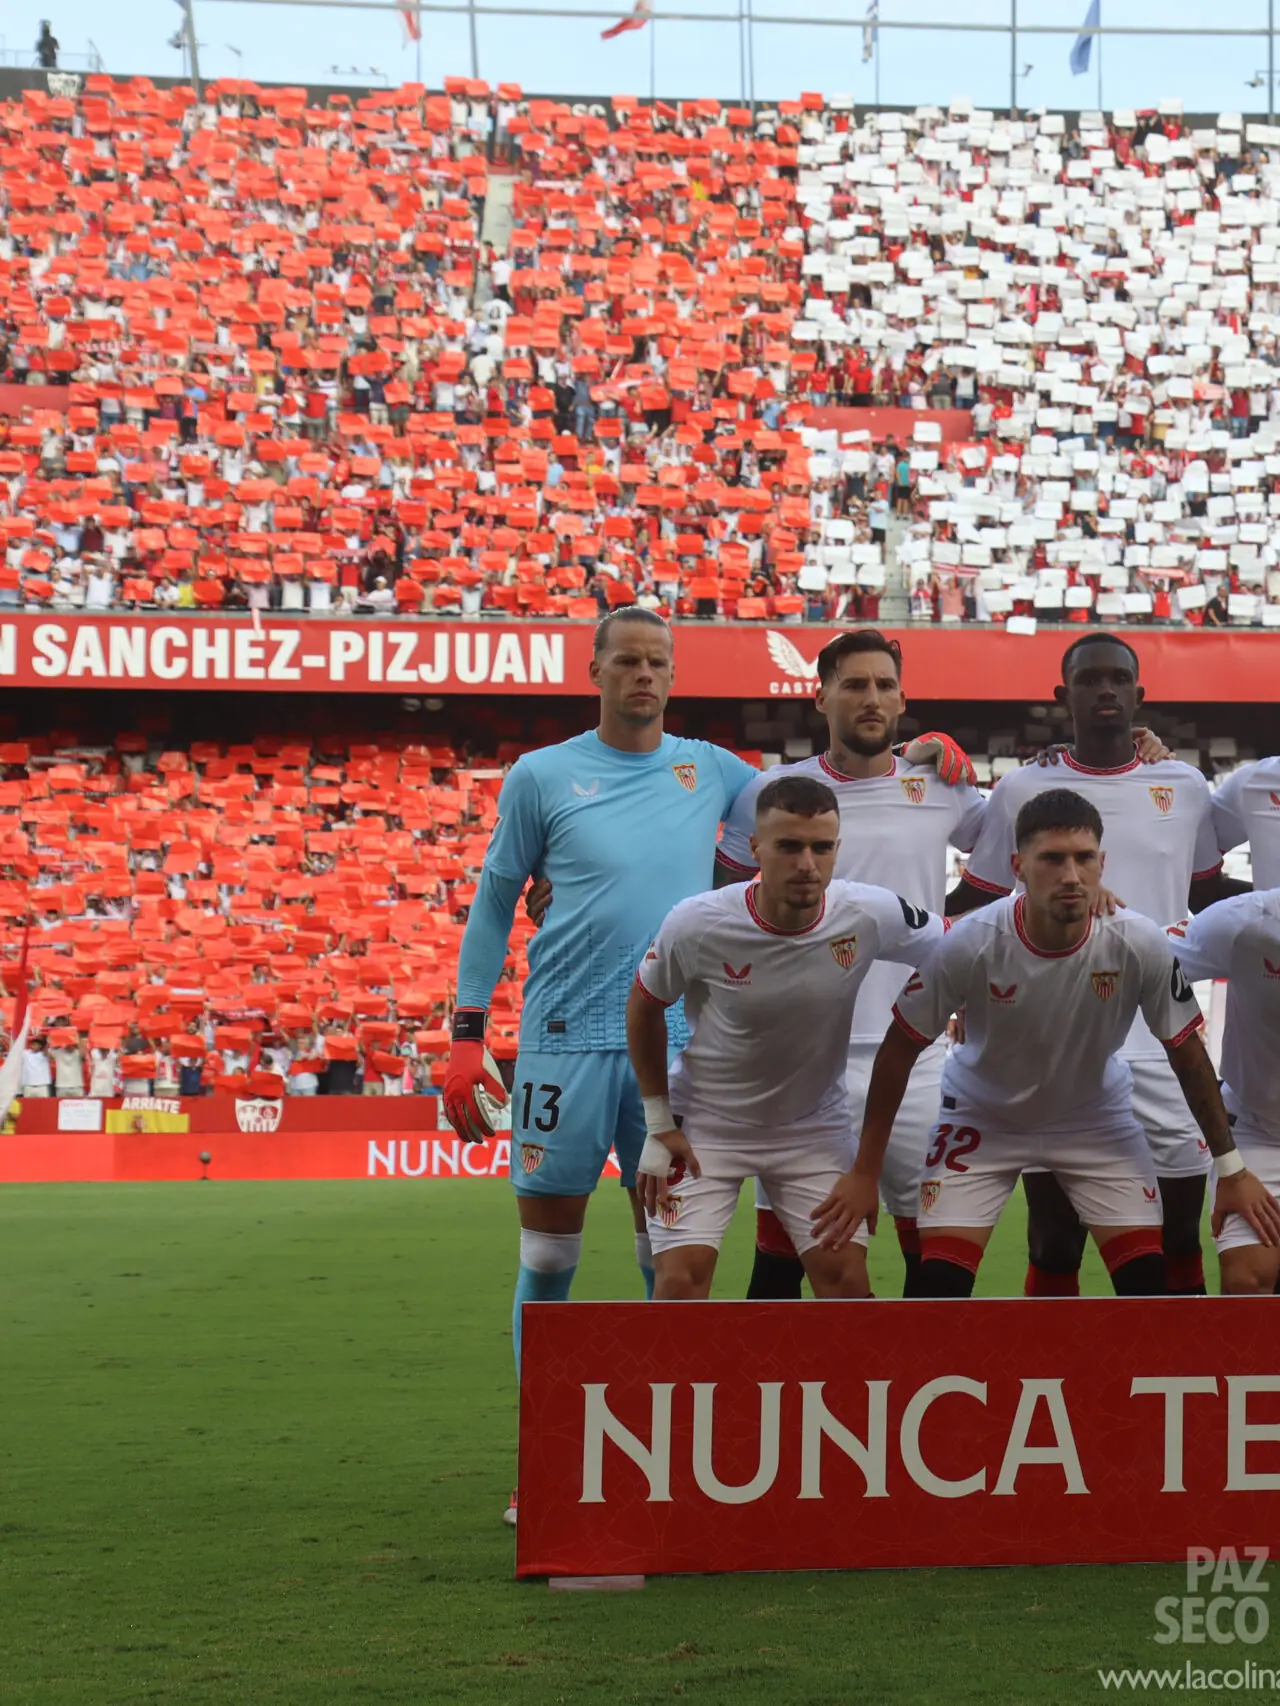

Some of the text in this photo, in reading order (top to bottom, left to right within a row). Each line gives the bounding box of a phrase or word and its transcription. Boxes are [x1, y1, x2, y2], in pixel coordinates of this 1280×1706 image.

[31, 623, 564, 684] SANCHEZ-PIZJUAN
[121, 1096, 181, 1115] ARRIATE
[523, 1082, 562, 1132] 13
[926, 1123, 981, 1172] 32
[578, 1375, 1091, 1505] NUNCA
